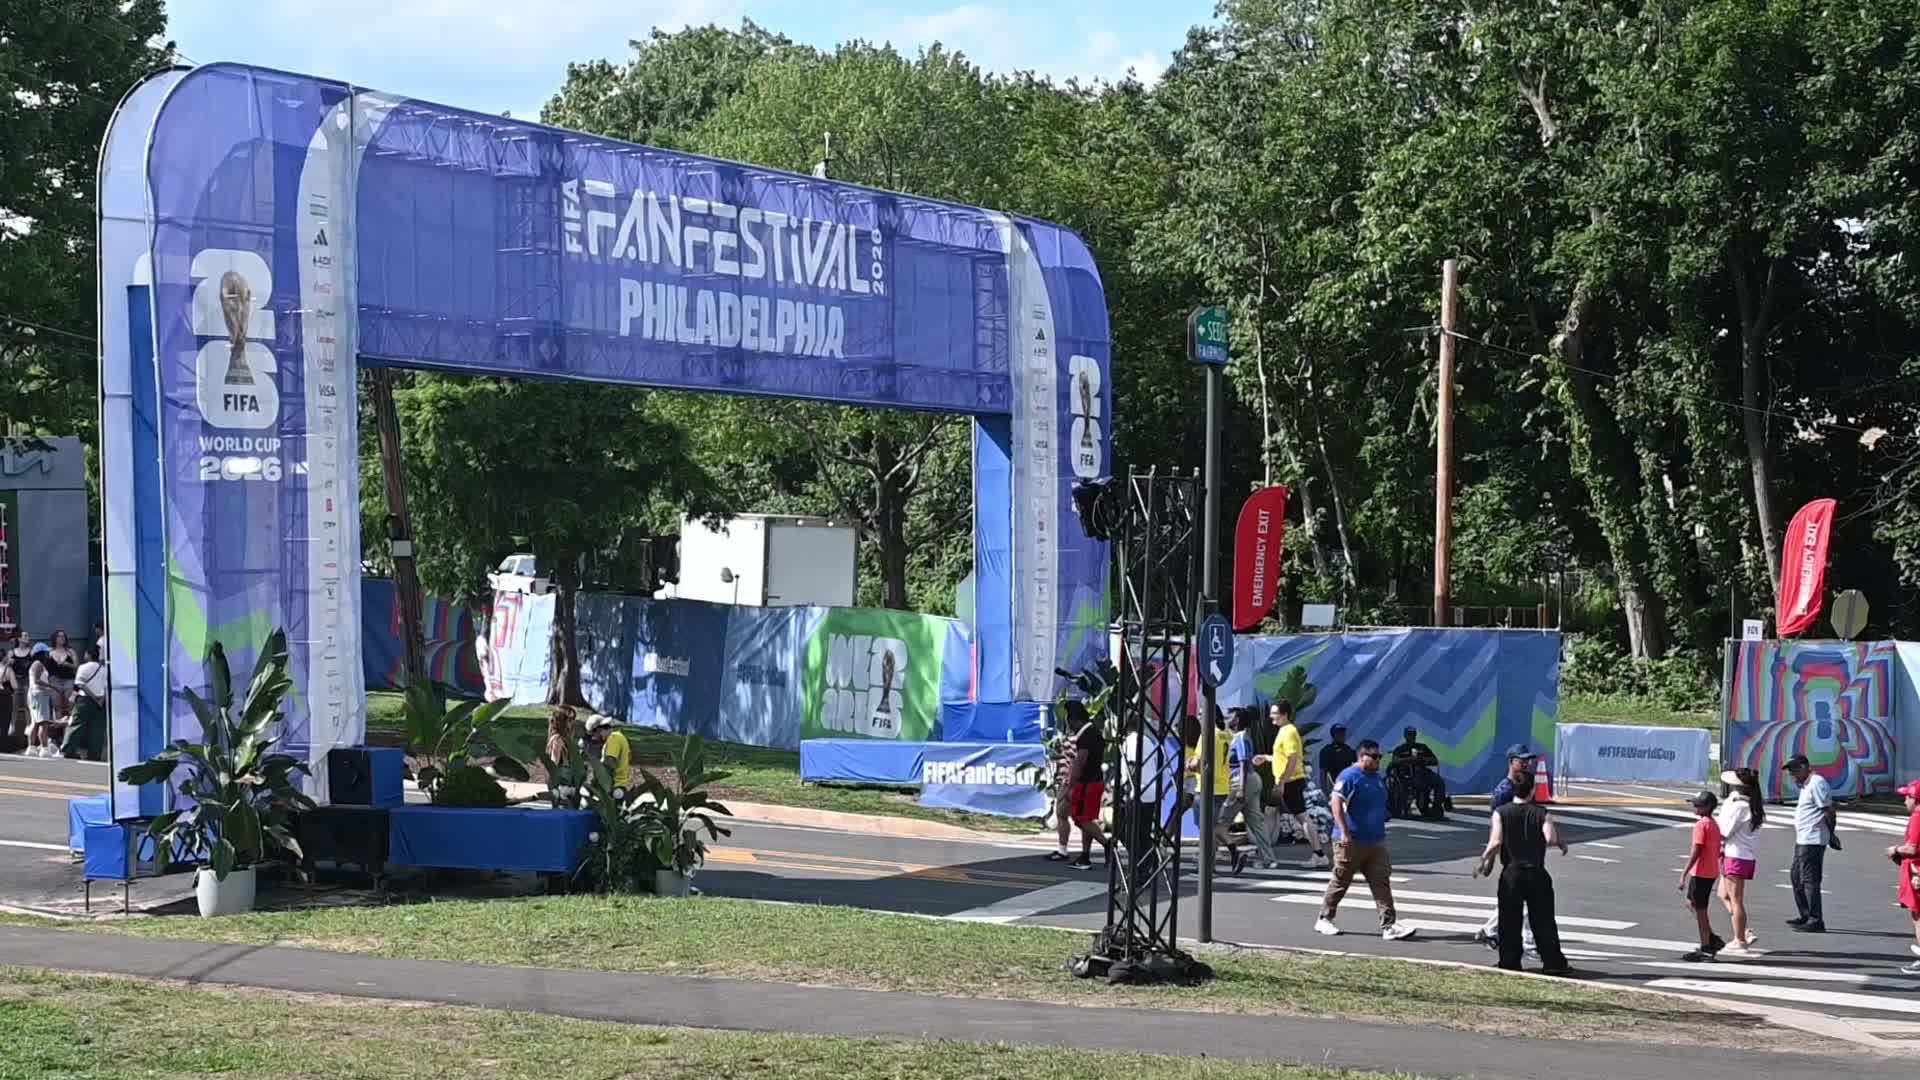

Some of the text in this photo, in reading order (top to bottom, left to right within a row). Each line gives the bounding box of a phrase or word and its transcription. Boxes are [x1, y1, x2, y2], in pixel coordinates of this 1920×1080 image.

[562, 178, 583, 253] FIFA
[871, 228, 885, 297] 2026
[619, 278, 845, 359] PHILADELPHIA
[223, 393, 260, 413] FIFA
[199, 436, 281, 453] WORLD CUP
[200, 455, 282, 482] 2026
[1252, 509, 1271, 607] EMERGENCY EXIT
[871, 716, 892, 729] FIFA
[1598, 745, 1676, 762] #FIFAWorldCup
